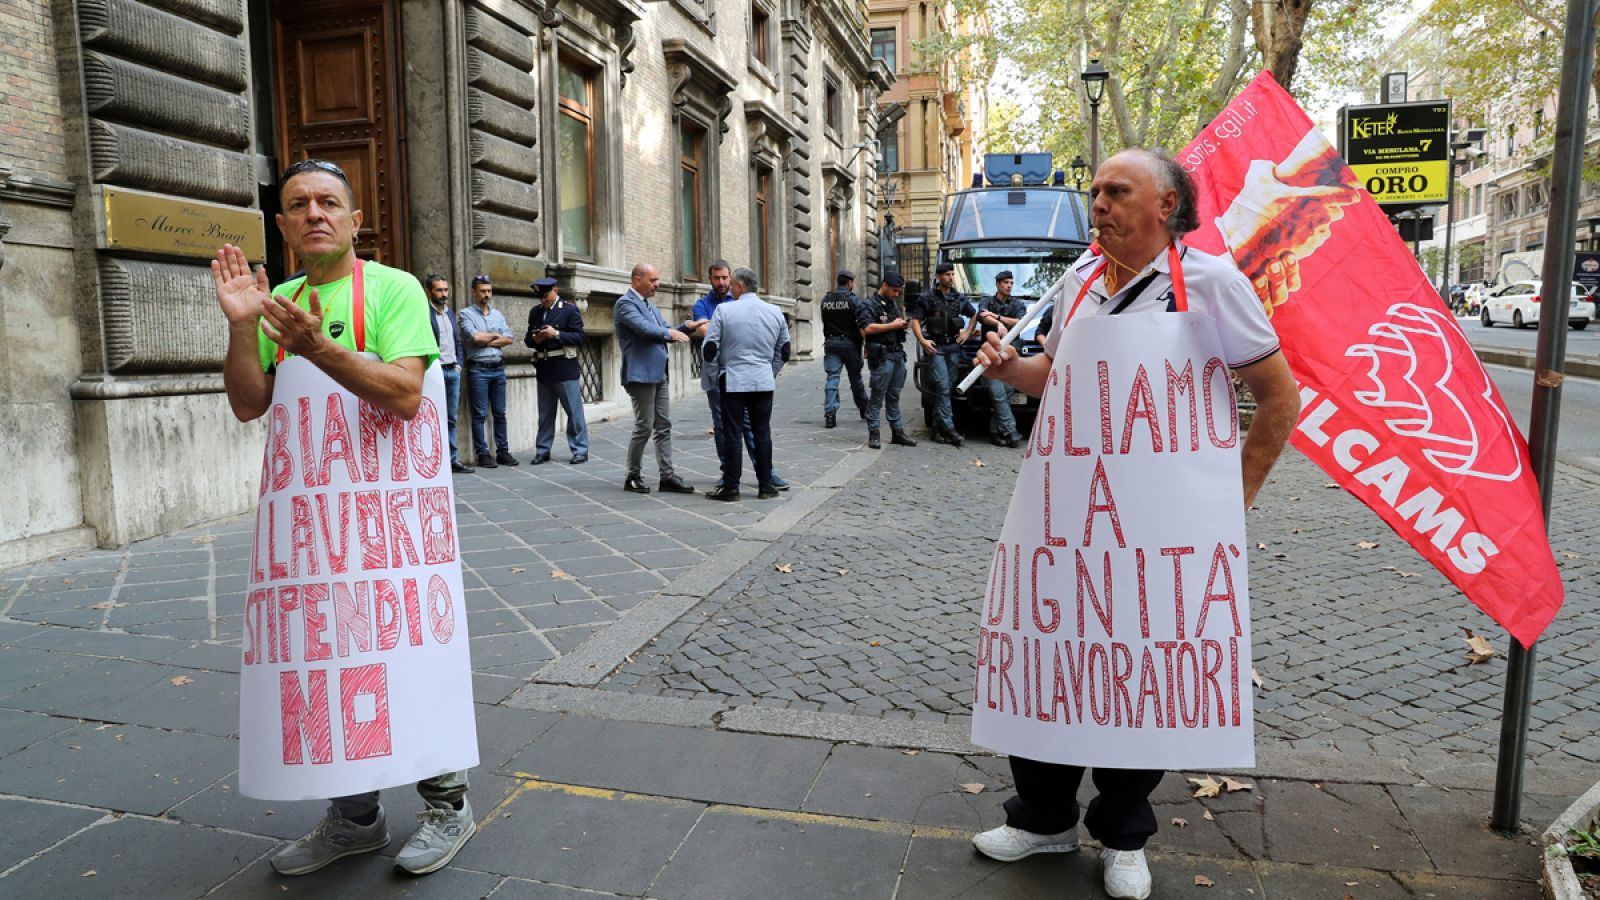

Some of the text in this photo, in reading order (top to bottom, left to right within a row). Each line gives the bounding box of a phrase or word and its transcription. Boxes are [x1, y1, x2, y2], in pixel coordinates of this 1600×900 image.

[1420, 139, 1432, 152] 7
[1375, 166, 1419, 175] COMPRO
[1366, 174, 1428, 195] ORO
[135, 215, 247, 243] Marco Biagi
[823, 300, 849, 310] POLIZIA
[1044, 456, 1126, 548] LA
[244, 574, 455, 666] STIPENDIO
[280, 663, 392, 765] NO
